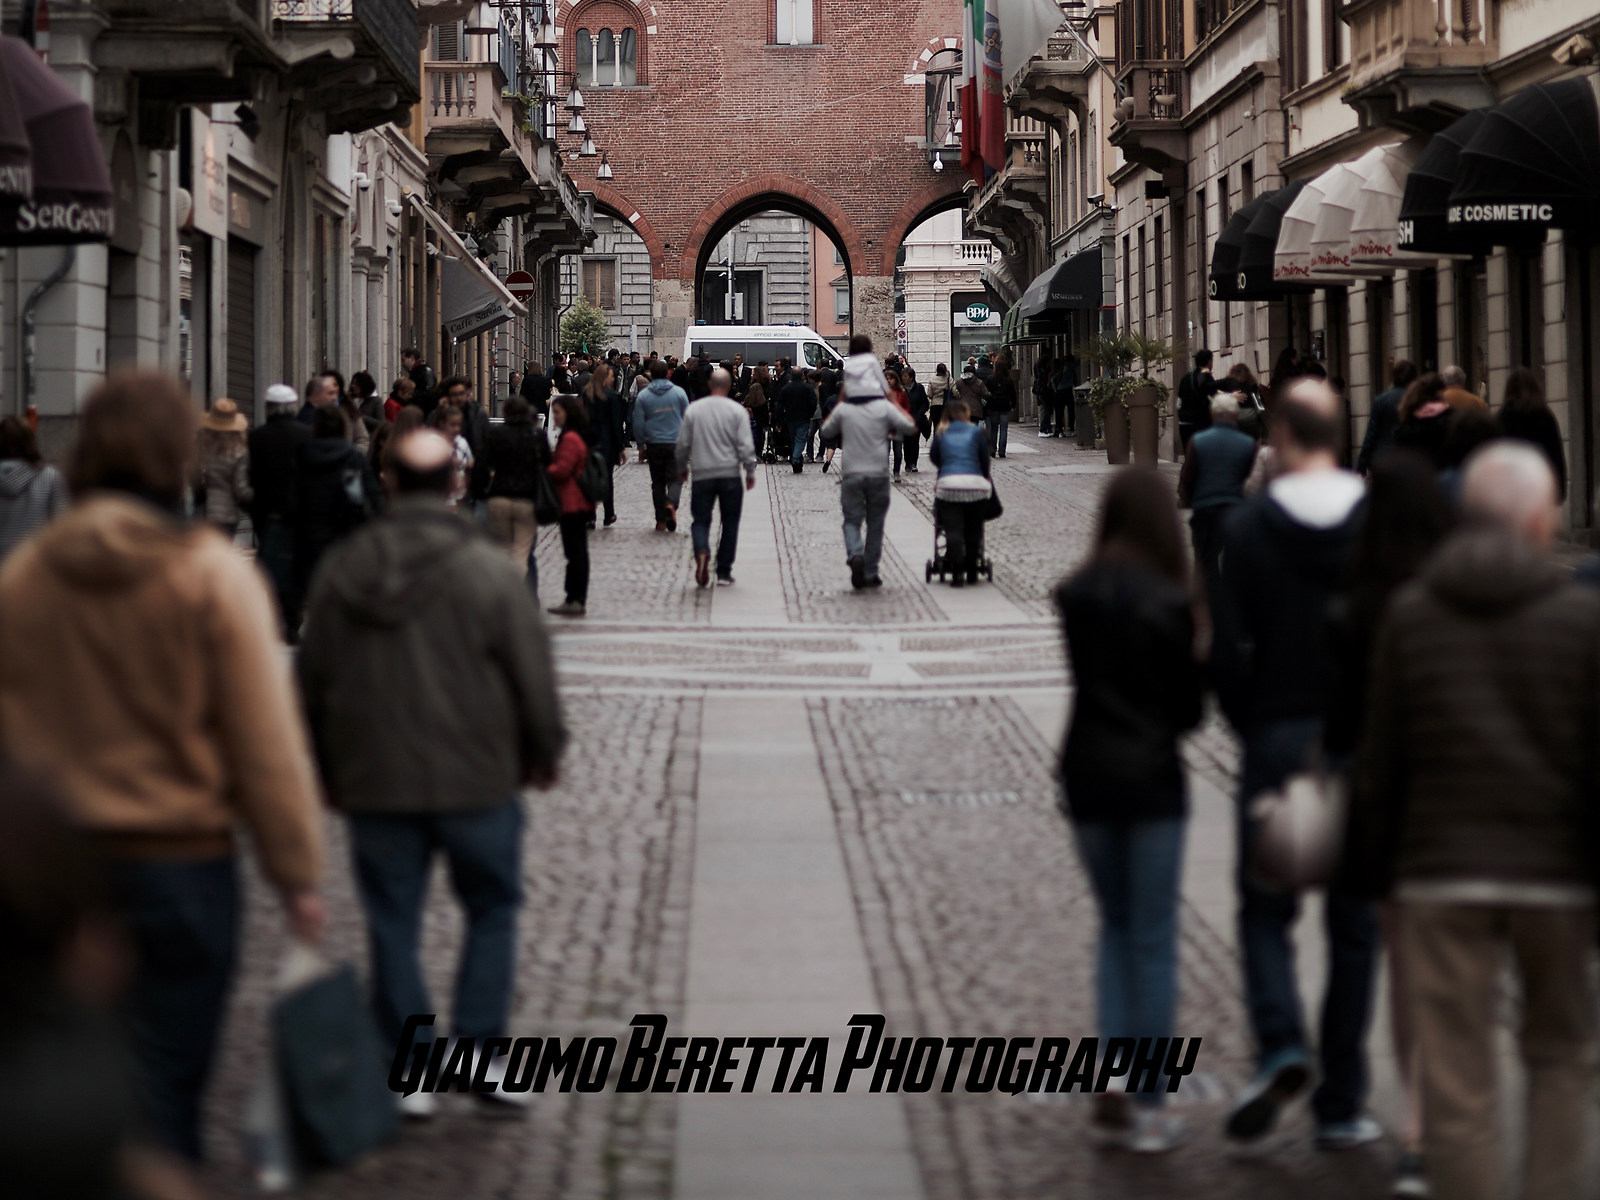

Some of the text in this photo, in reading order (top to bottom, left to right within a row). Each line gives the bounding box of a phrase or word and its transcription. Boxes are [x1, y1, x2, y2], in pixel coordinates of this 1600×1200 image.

[1464, 205, 1553, 221] COSMETIC
[1359, 240, 1393, 257] même
[1318, 251, 1351, 267] même
[1281, 262, 1310, 277] même
